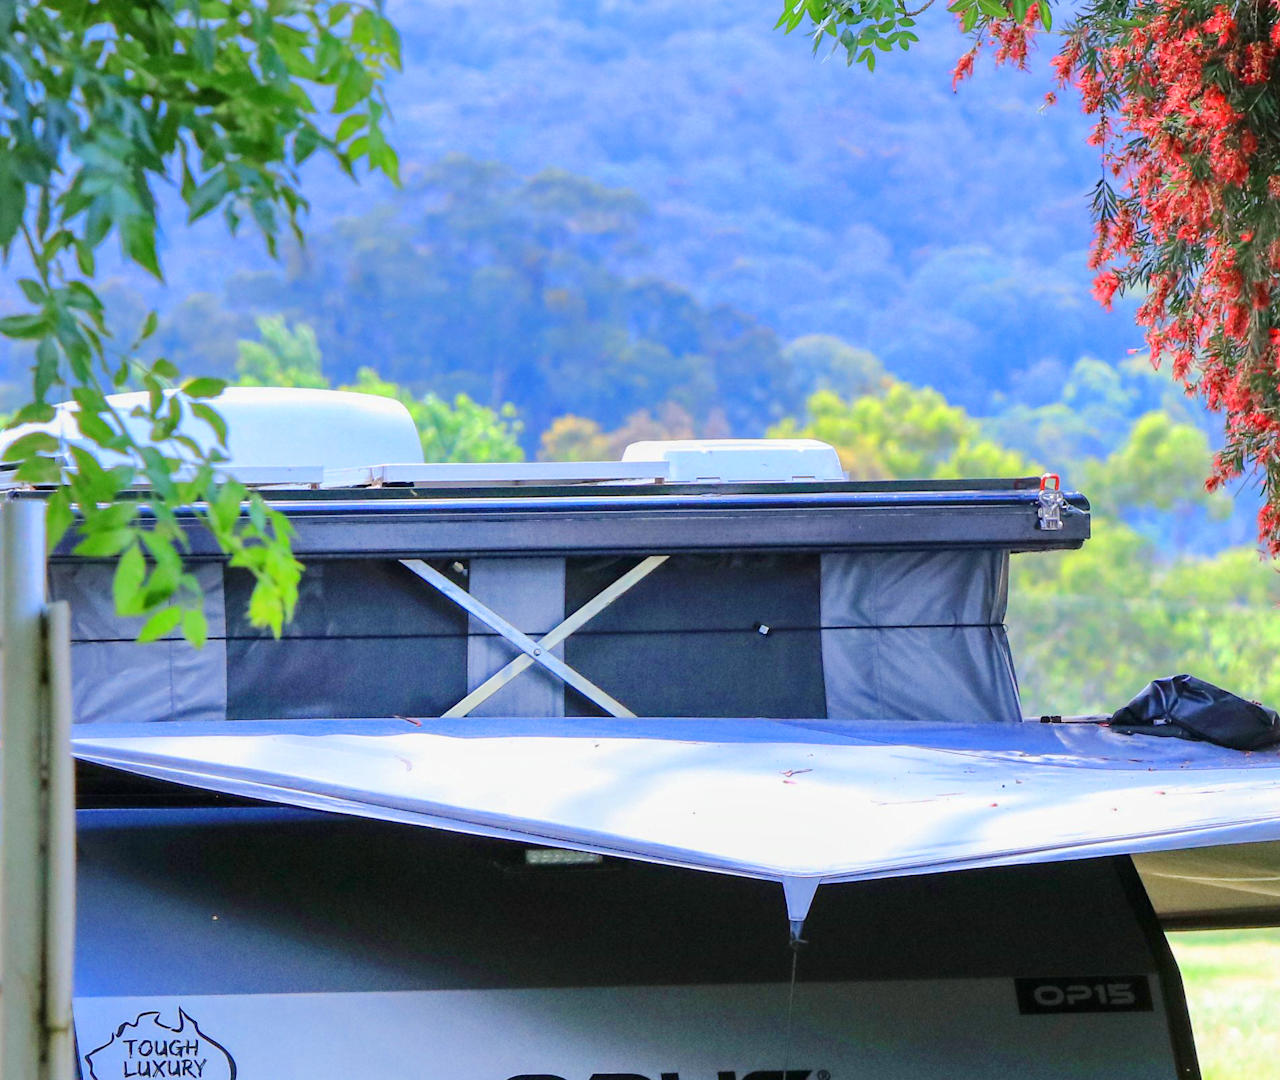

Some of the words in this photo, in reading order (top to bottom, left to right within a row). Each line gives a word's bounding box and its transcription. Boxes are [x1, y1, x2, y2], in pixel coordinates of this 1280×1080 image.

[1033, 983, 1136, 1006] OP15
[123, 1039, 199, 1058] TOUGH
[123, 1058, 207, 1078] LUXURY
